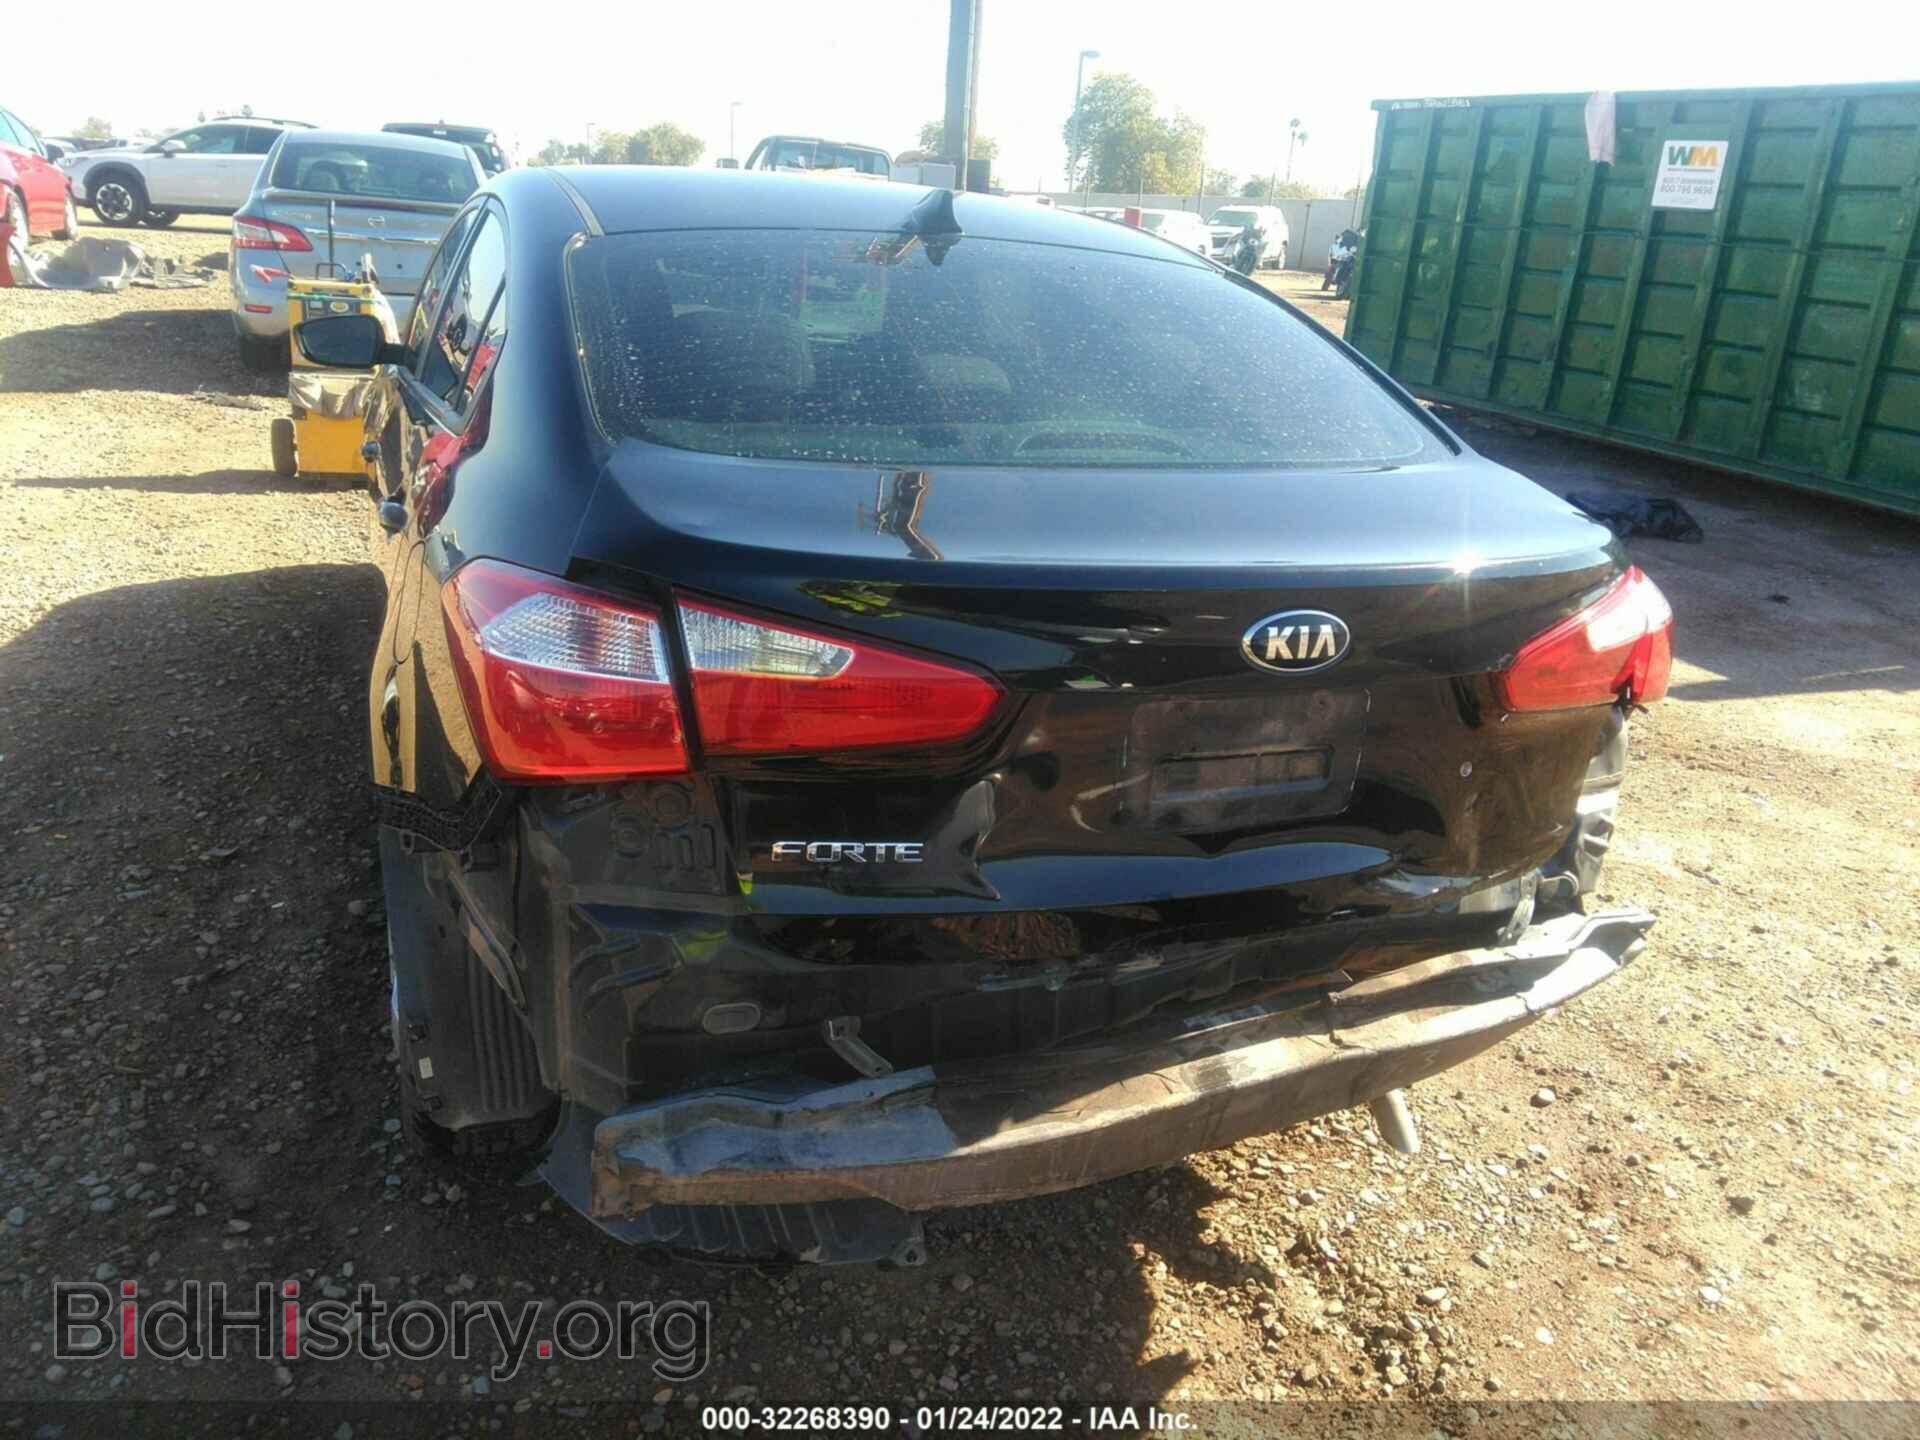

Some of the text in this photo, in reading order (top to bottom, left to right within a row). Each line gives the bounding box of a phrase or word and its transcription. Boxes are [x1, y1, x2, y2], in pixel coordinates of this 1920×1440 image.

[1668, 146, 1719, 166] WM
[1265, 624, 1336, 660] KIA
[771, 841, 924, 864] FORTE
